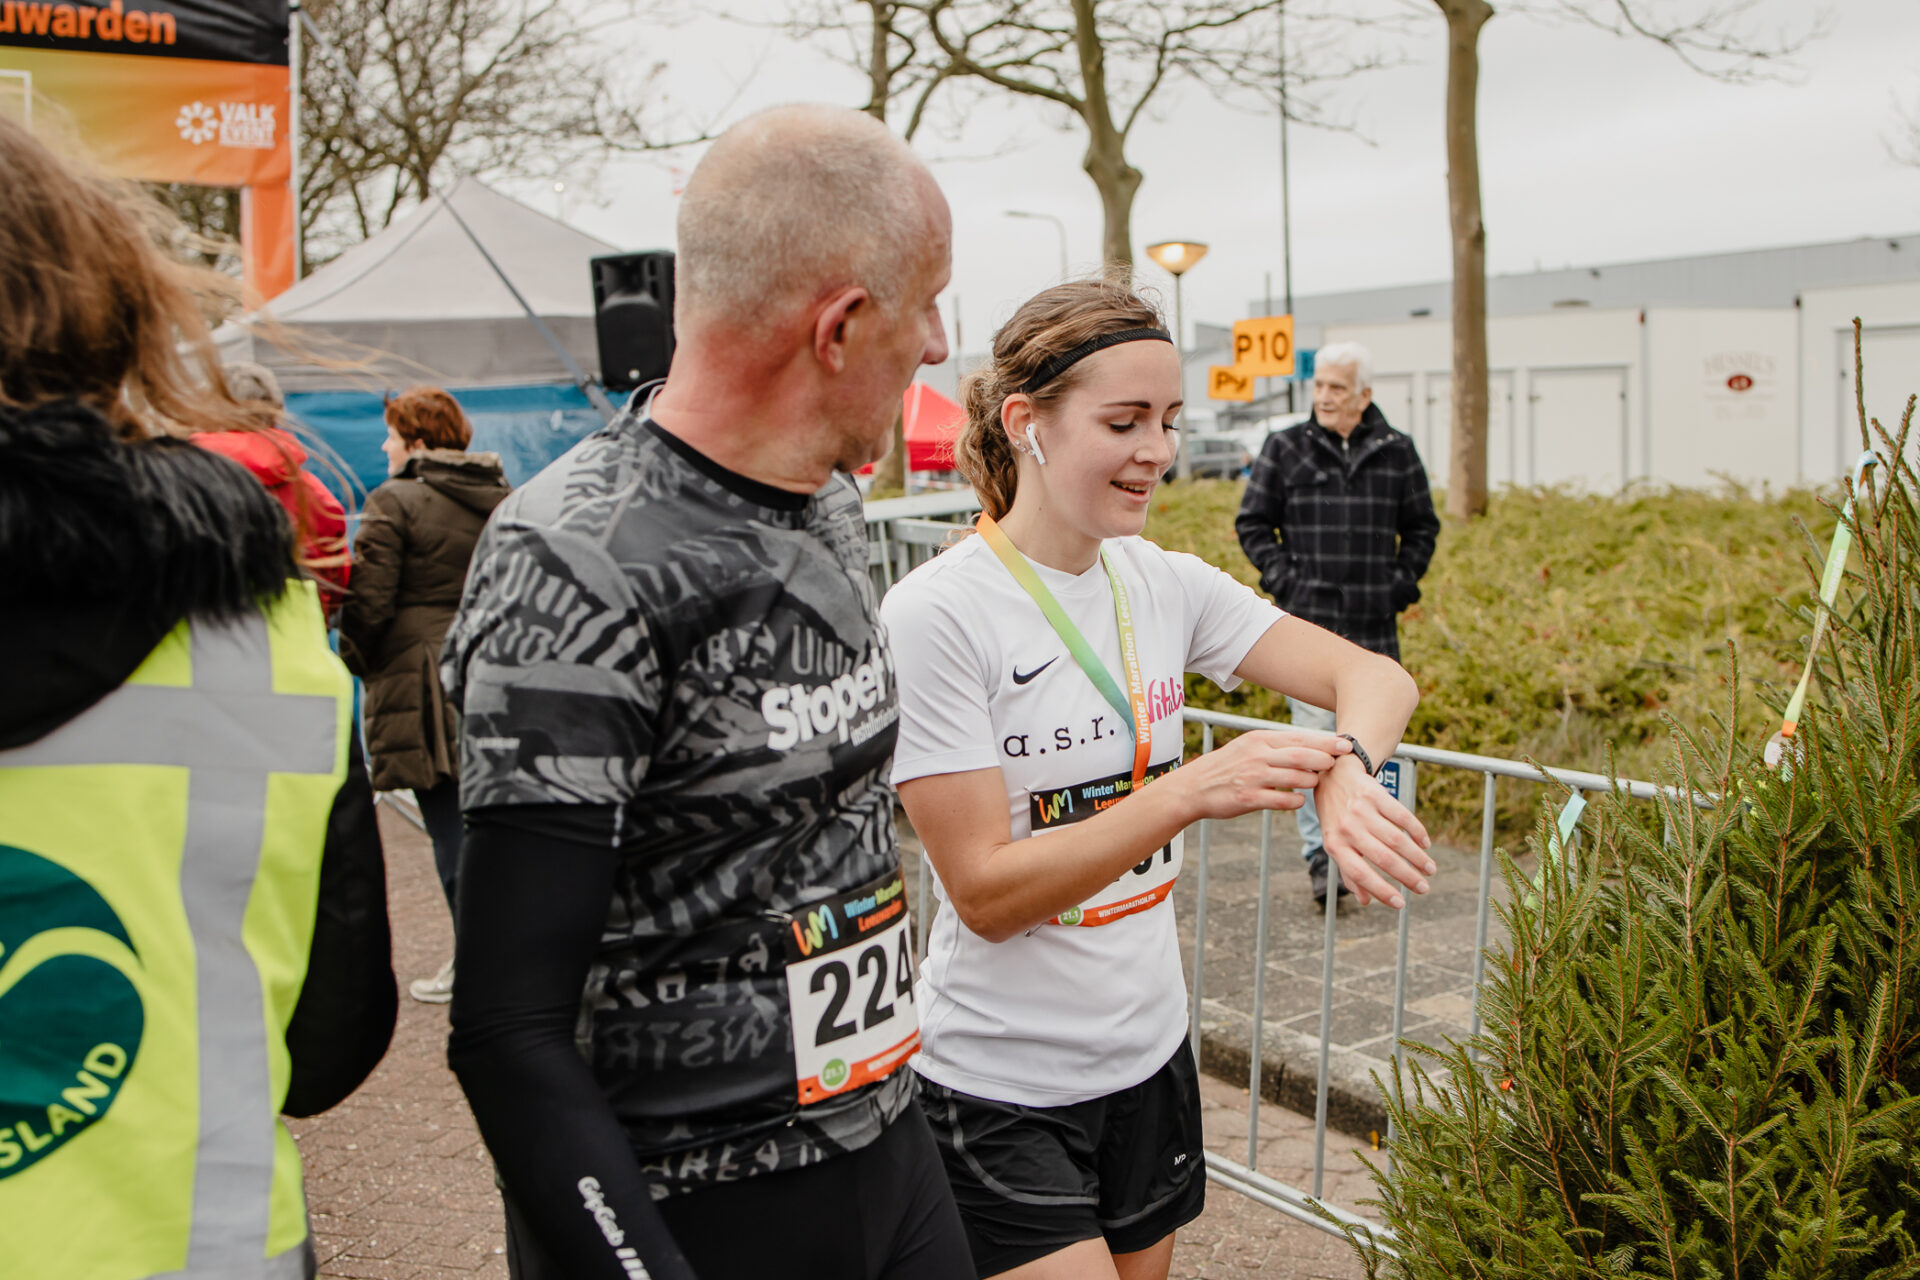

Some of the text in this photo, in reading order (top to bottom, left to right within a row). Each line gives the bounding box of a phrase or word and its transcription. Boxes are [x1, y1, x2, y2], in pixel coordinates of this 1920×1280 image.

[219, 101, 276, 120] VALK
[1235, 331, 1289, 363] P10
[1123, 632, 1143, 695] Marathon
[1003, 716, 1115, 758] a.s.r.
[1135, 700, 1150, 745] Winter
[1081, 784, 1115, 800] Winter
[1062, 910, 1079, 921] 21.1
[810, 928, 914, 1048] 224
